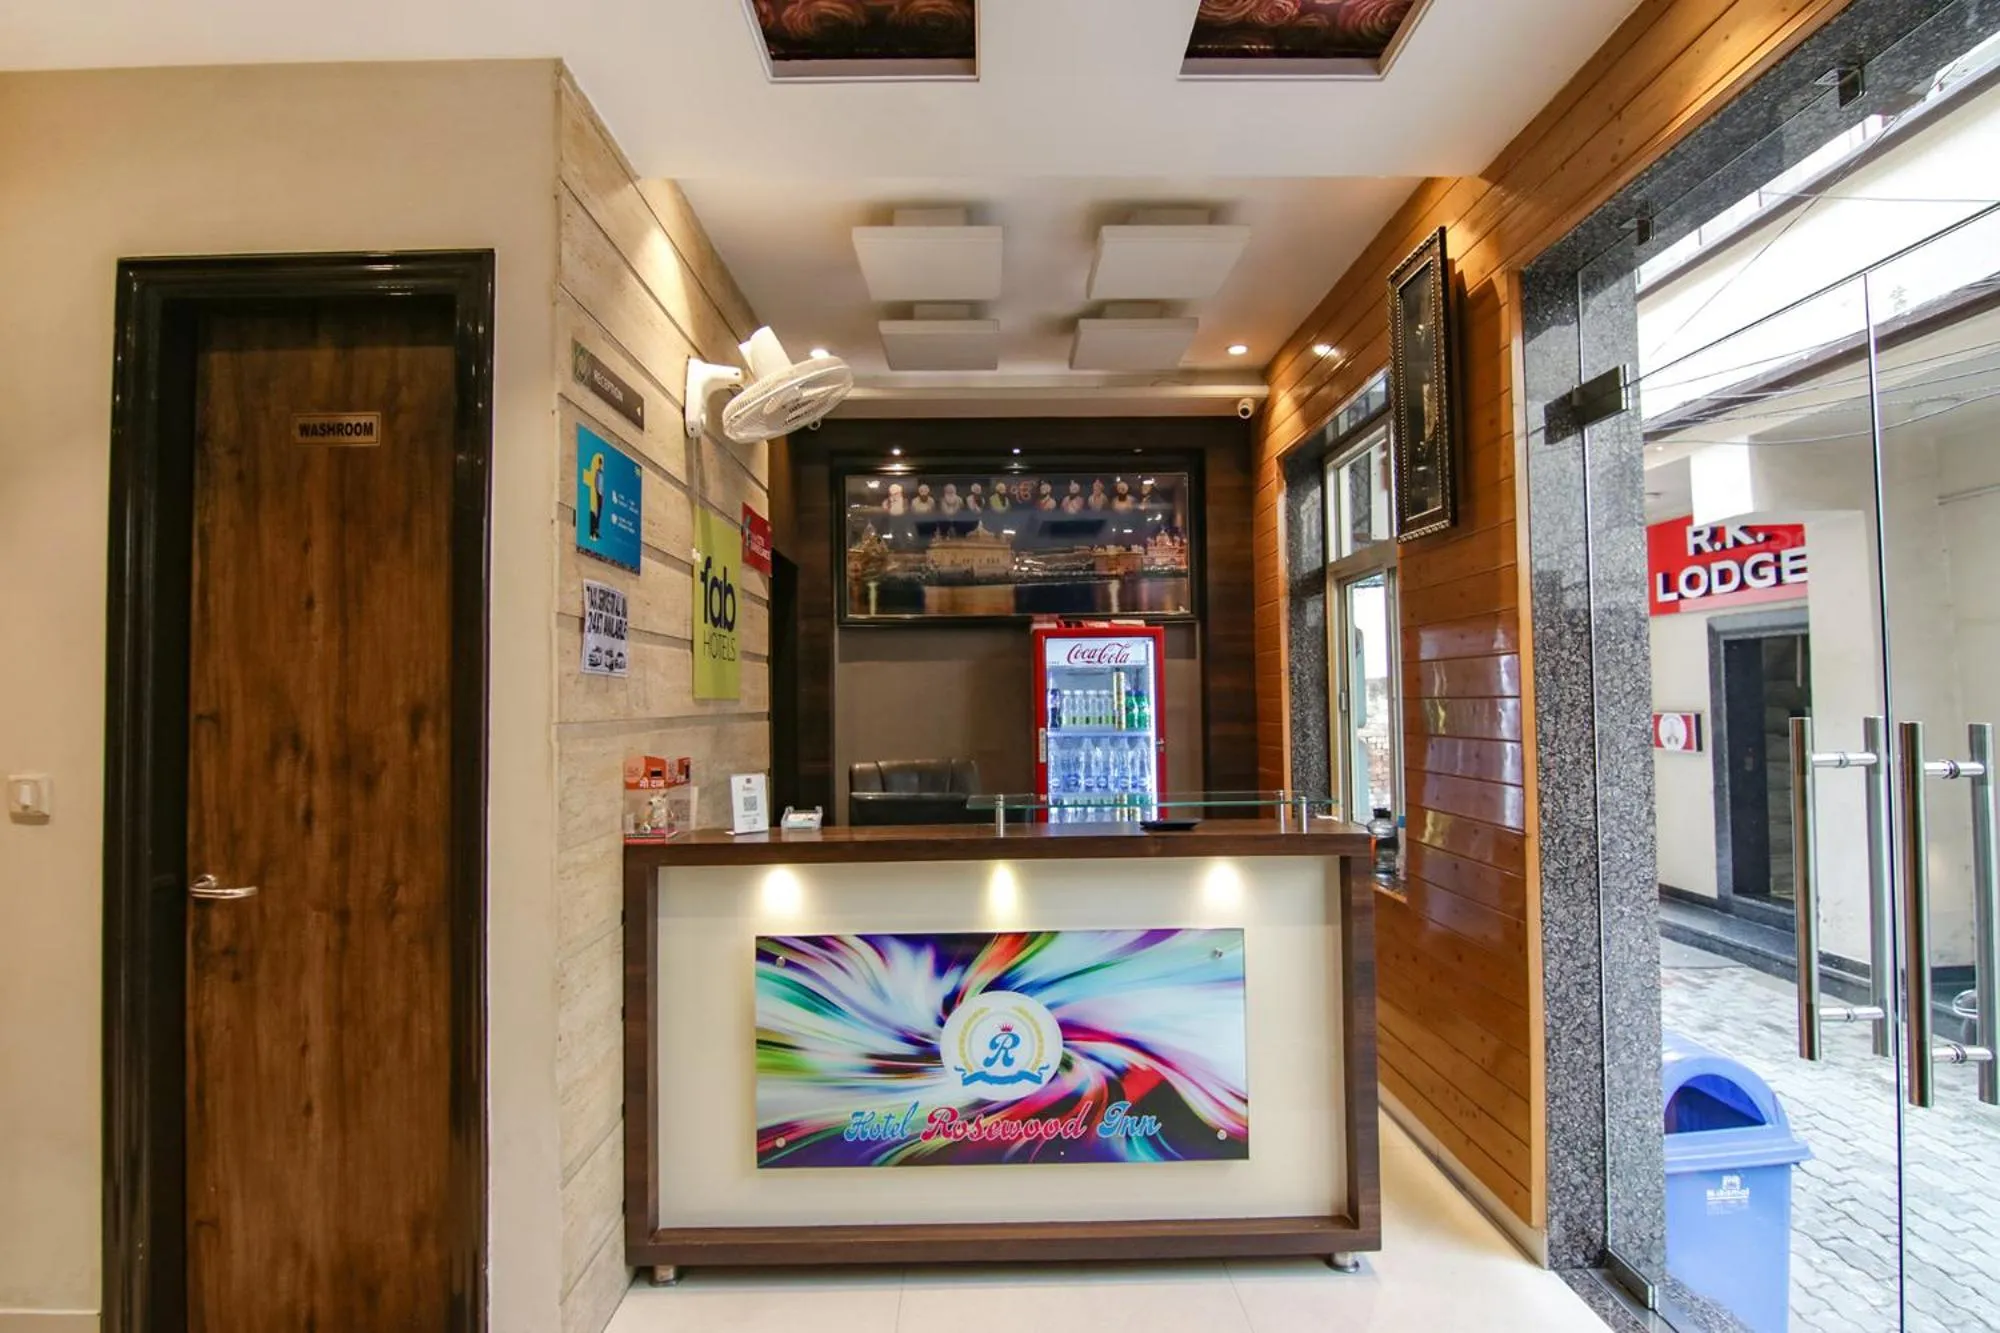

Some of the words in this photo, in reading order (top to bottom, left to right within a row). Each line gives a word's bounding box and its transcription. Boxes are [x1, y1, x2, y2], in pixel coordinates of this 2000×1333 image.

[298, 421, 374, 437] WASHROOM
[700, 556, 737, 634] fab
[1656, 547, 1809, 602] LODGE
[703, 629, 737, 662] HOTELS
[843, 1100, 920, 1142] Hotel
[920, 1100, 1091, 1142] Rosewood
[1096, 1101, 1163, 1138] Inn
